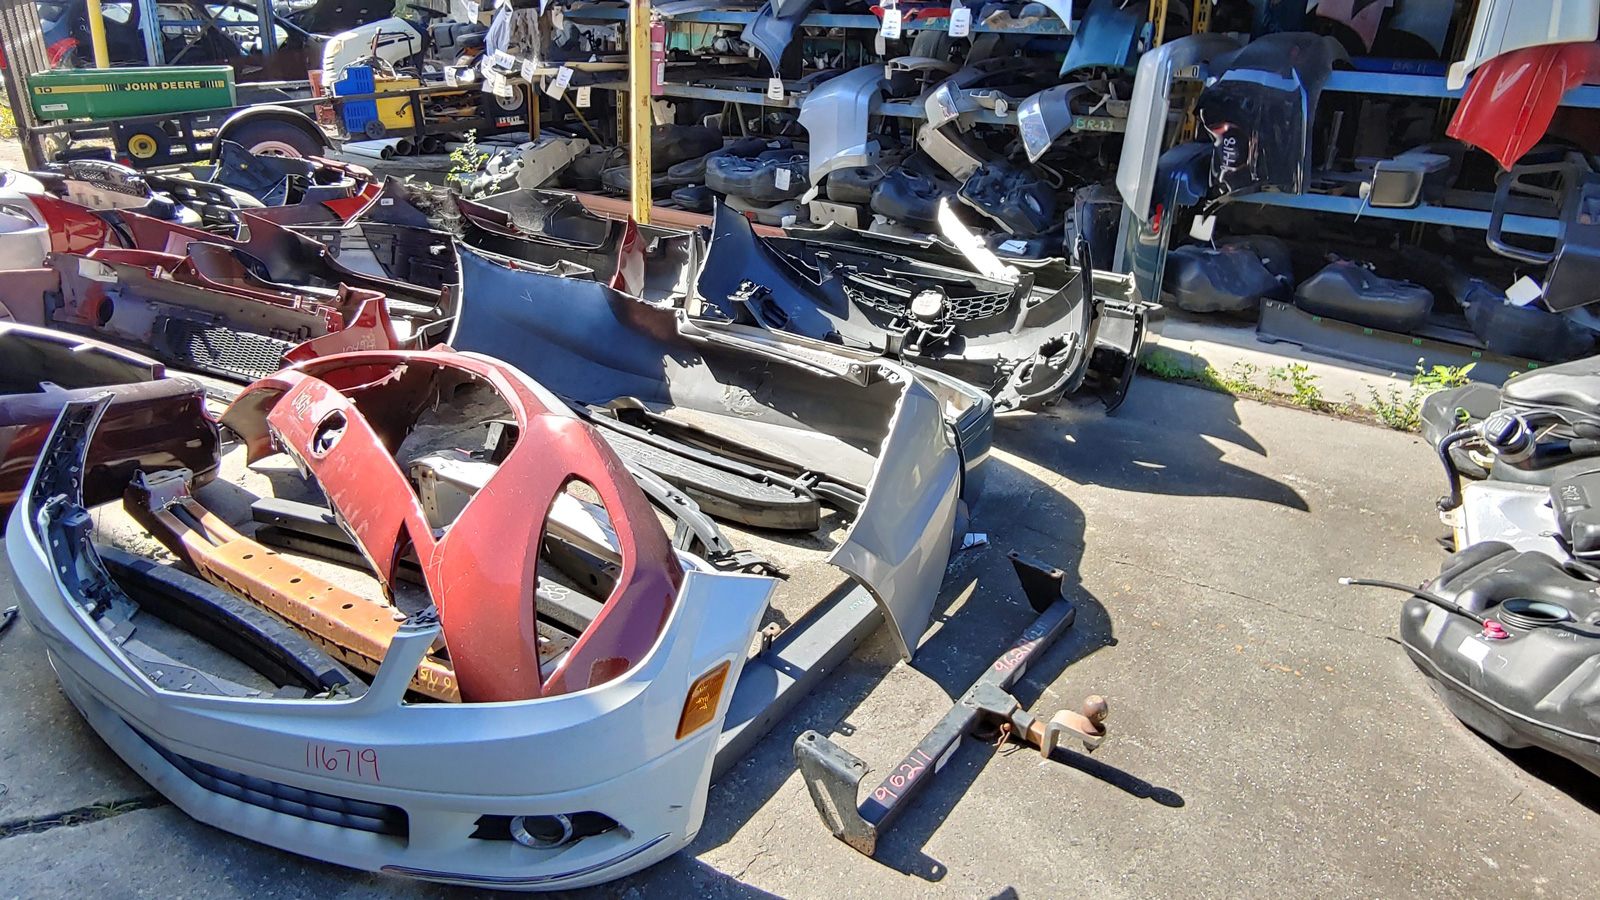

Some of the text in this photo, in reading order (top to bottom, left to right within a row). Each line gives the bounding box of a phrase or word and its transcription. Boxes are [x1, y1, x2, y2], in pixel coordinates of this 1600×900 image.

[124, 80, 200, 92] JOHN DEERE
[306, 741, 380, 781] 116719
[874, 749, 932, 801] 96211
